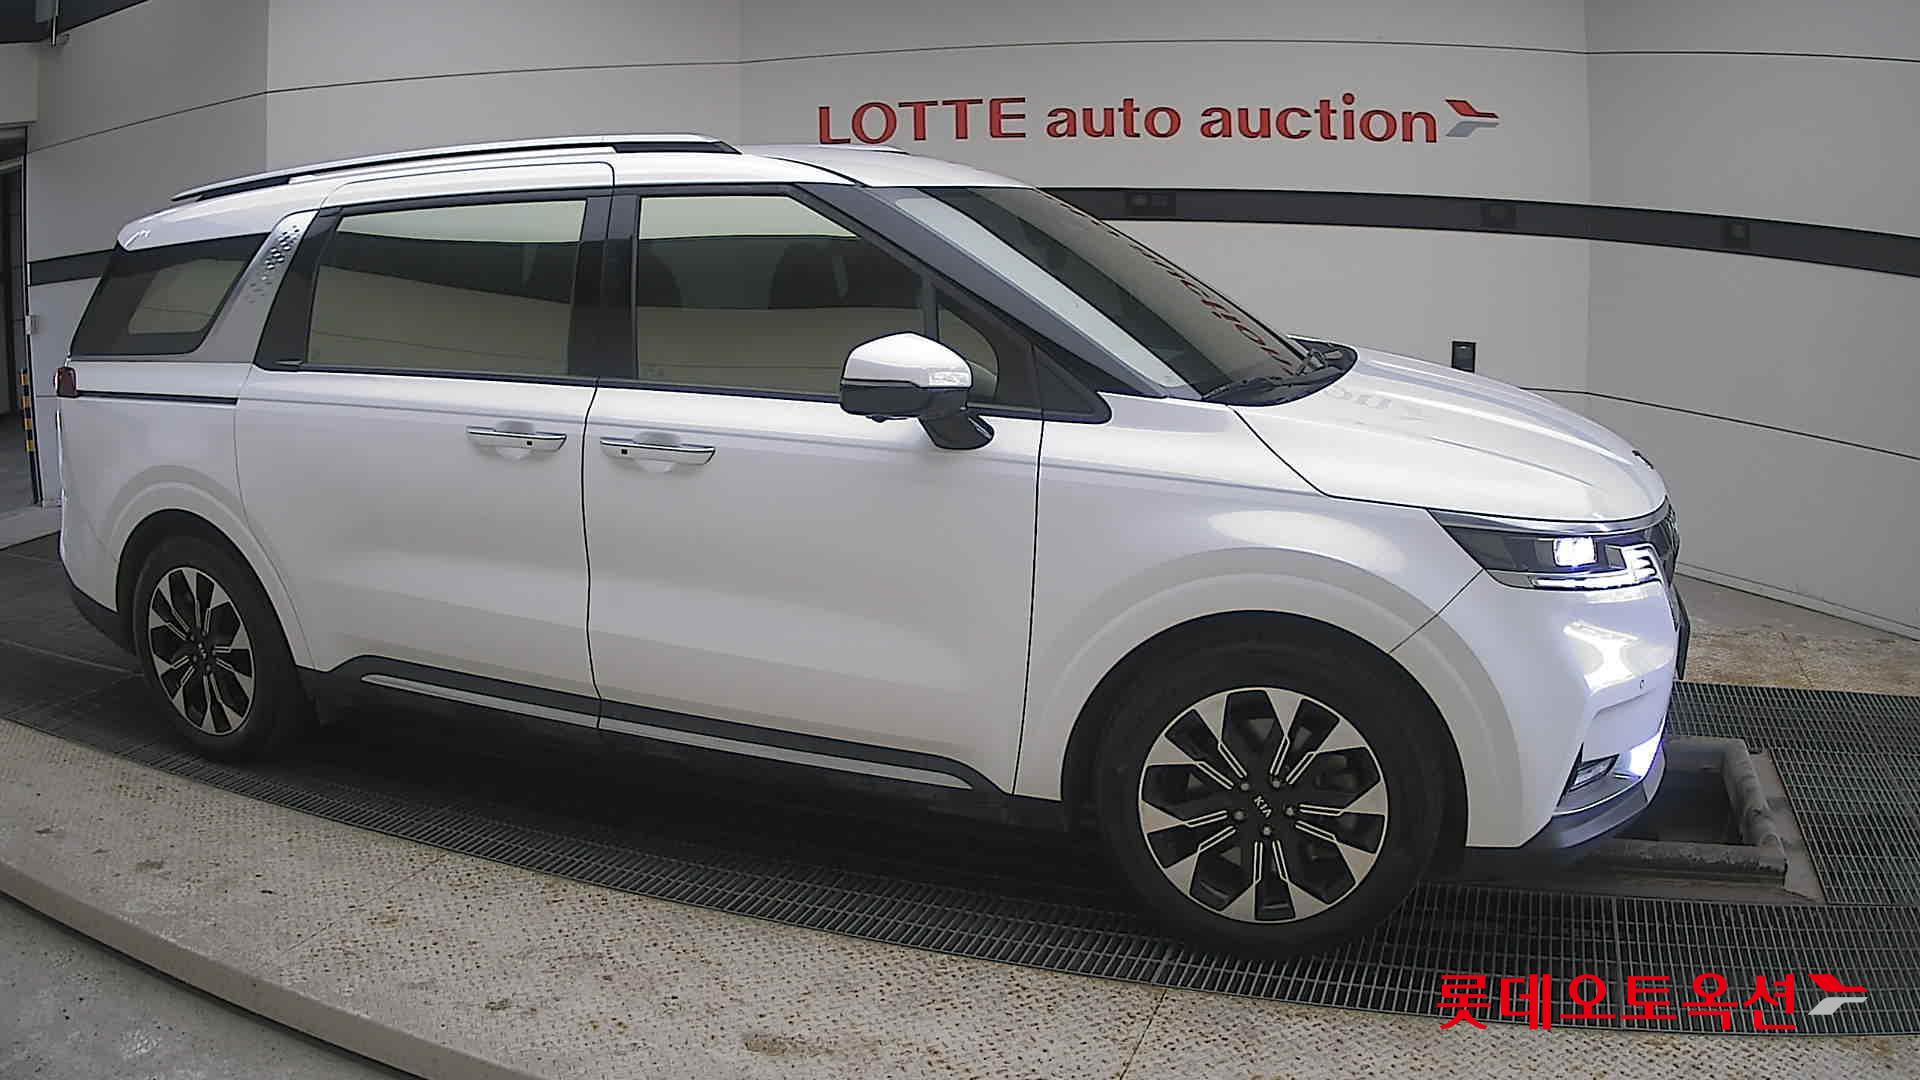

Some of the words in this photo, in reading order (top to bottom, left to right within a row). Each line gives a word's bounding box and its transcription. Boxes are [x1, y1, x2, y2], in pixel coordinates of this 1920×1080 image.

[818, 96, 1026, 145] LOTTE
[1046, 98, 1182, 139] auto
[1200, 93, 1438, 143] auction
[1253, 795, 1272, 818] KIA
